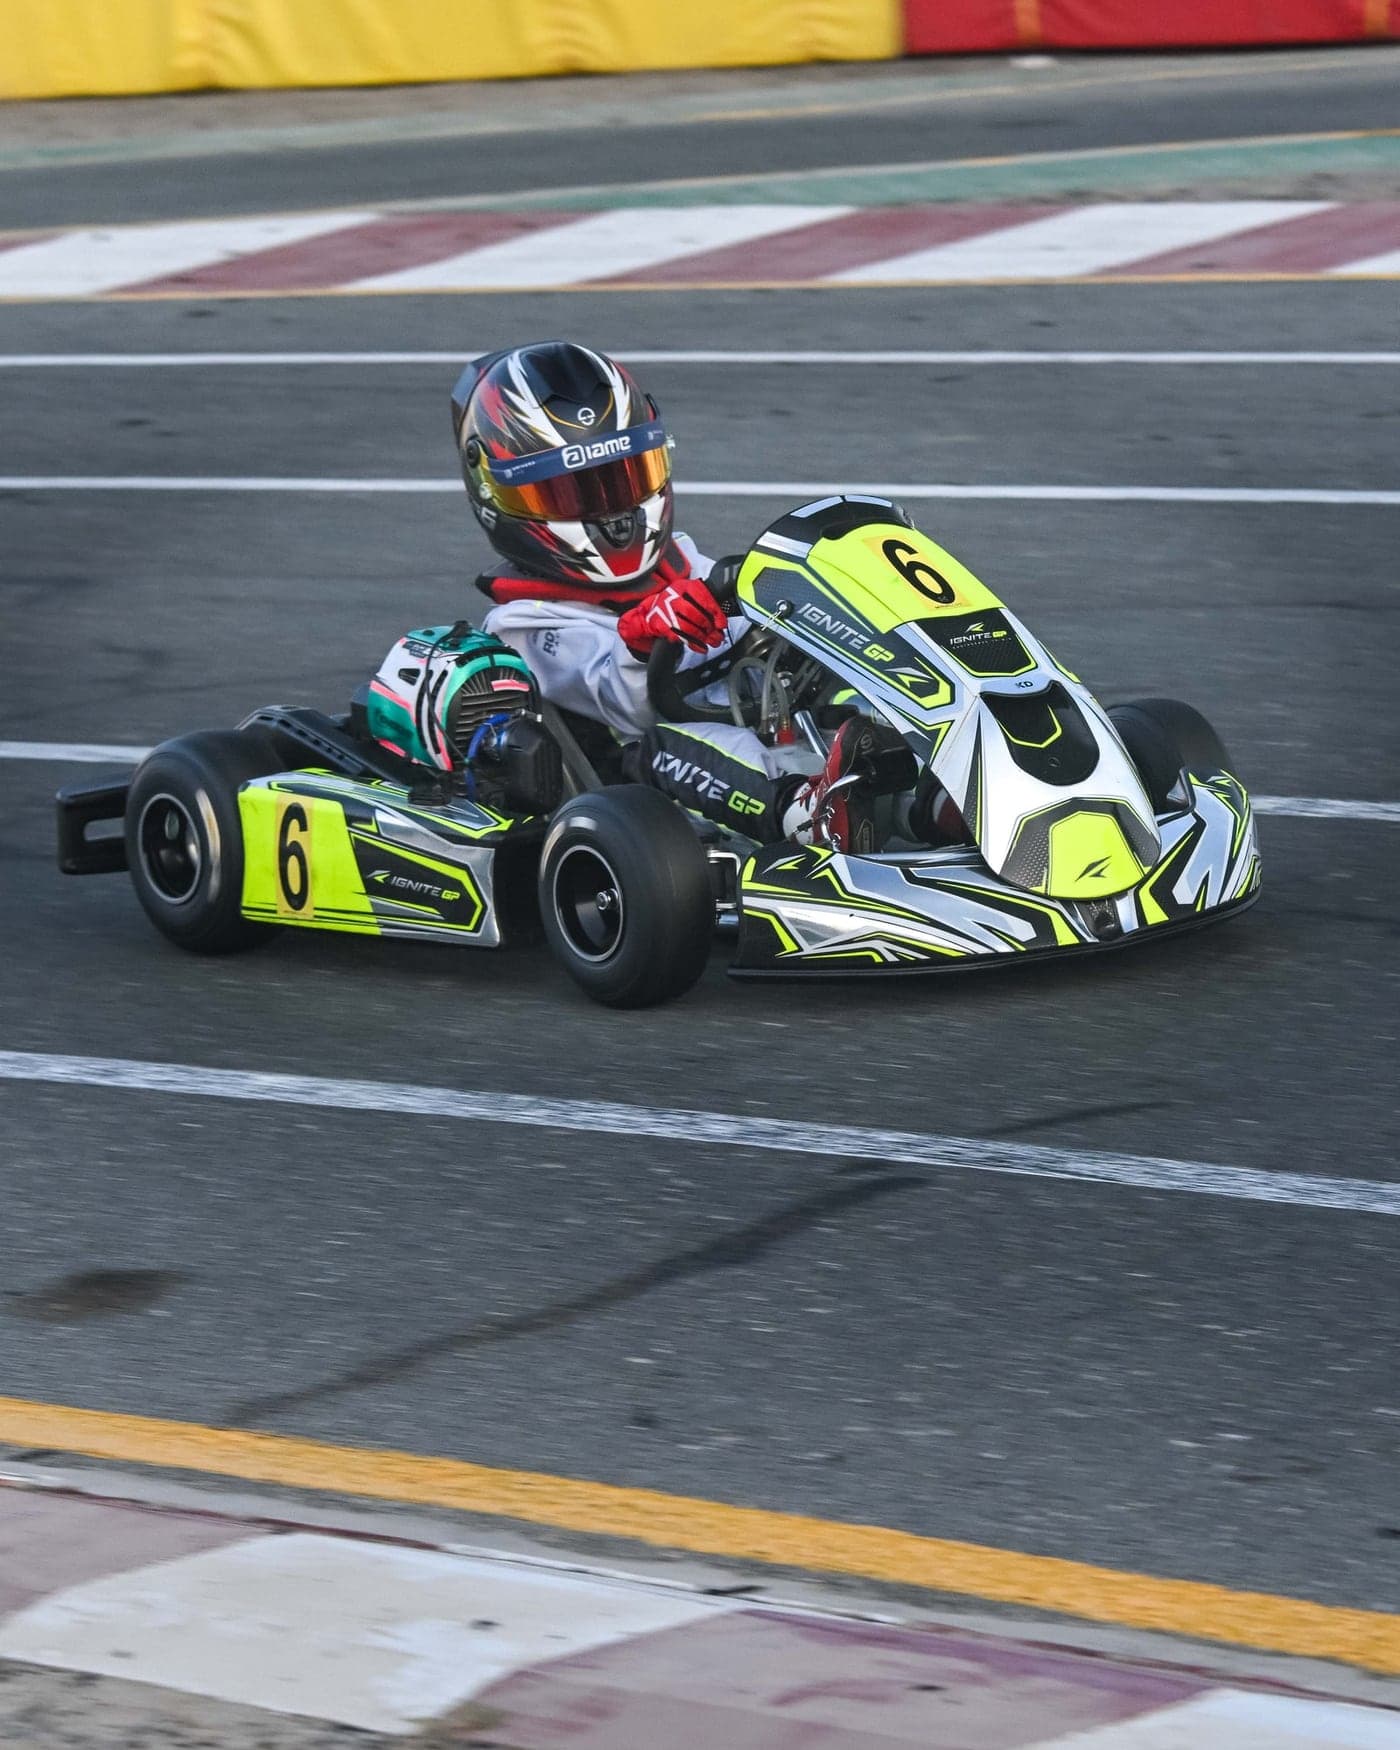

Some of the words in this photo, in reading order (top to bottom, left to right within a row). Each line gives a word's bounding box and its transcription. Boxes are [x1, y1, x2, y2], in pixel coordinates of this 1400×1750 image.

[882, 539, 955, 604] 6
[797, 603, 871, 650] IGNITE
[863, 643, 895, 662] GP
[950, 632, 992, 645] IGNITE
[728, 790, 767, 816] GP
[278, 802, 308, 911] 6
[391, 876, 442, 896] IGNITE
[441, 890, 460, 900] GP
